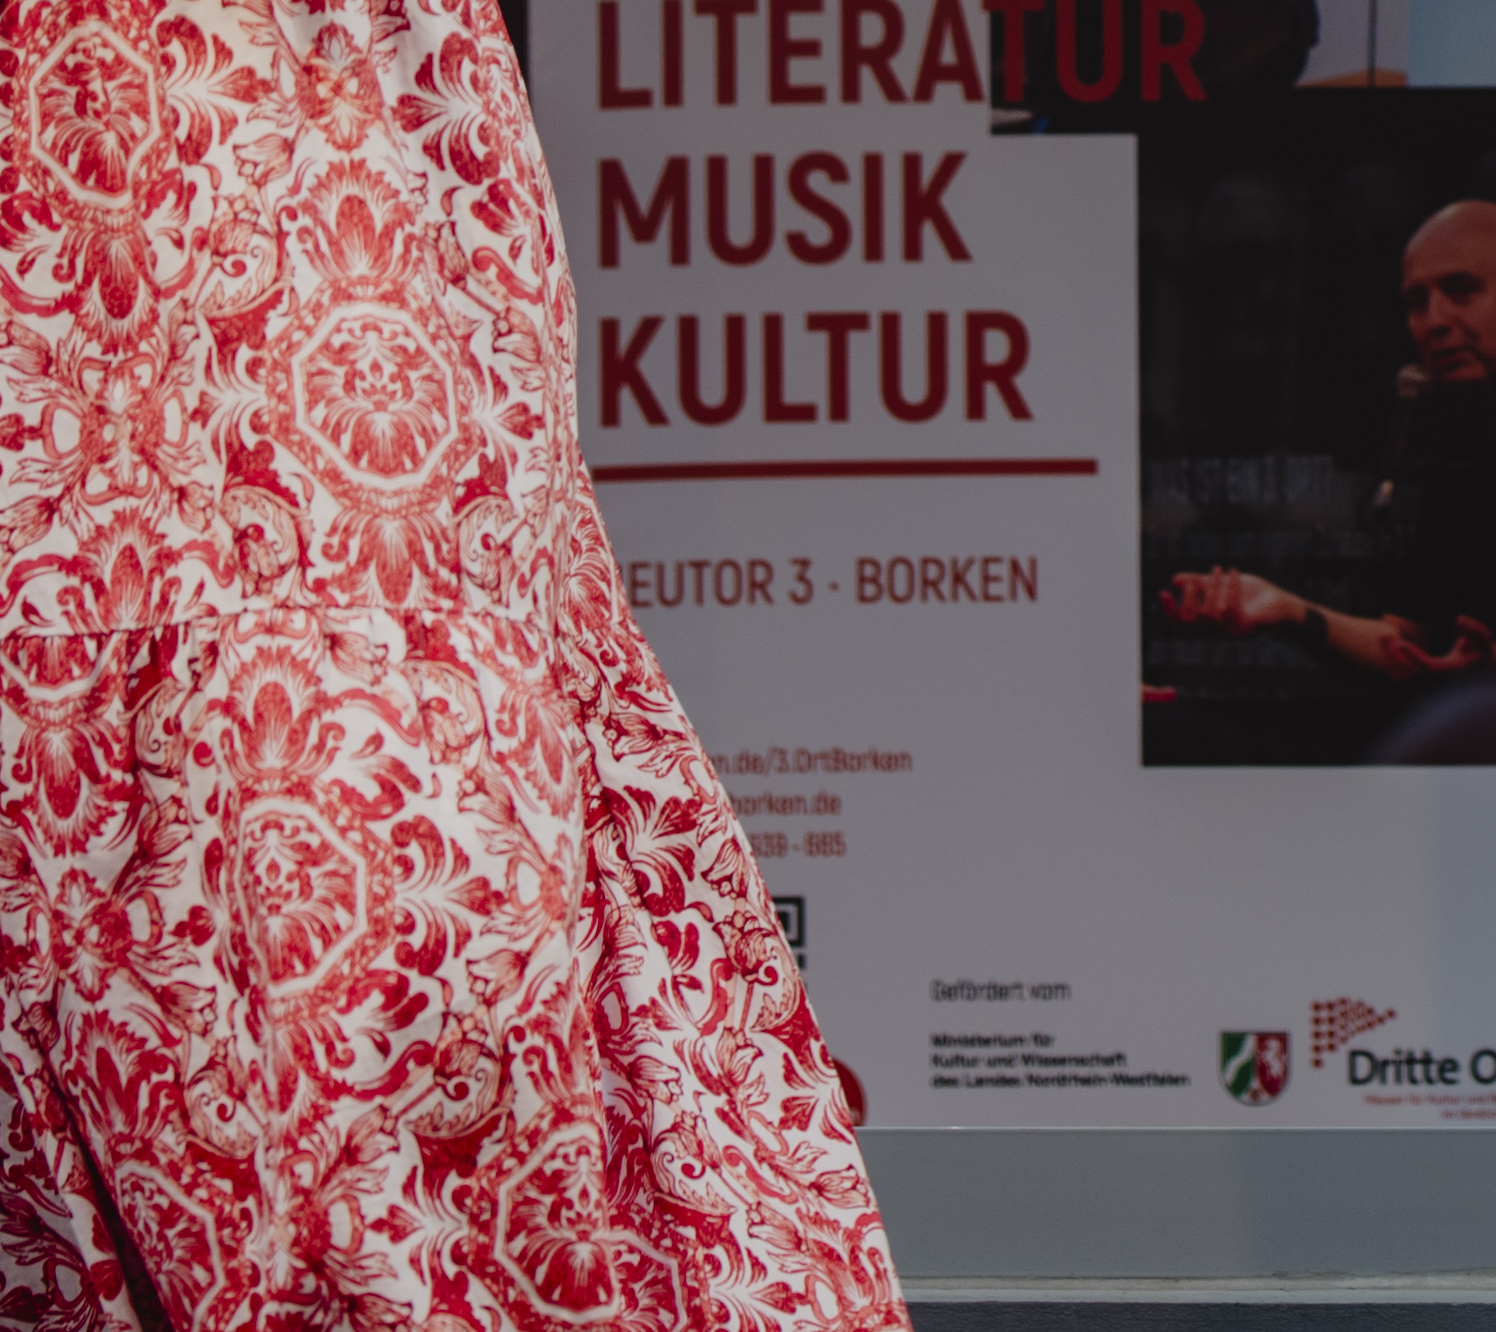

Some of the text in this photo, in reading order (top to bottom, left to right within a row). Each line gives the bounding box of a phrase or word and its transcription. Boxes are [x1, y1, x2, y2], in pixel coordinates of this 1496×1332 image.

[597, 152, 974, 269] MUSIK
[598, 309, 1033, 429] KULTUR
[622, 559, 776, 608] EUTOR
[786, 557, 815, 606] 3
[856, 555, 1039, 606] BORKEN
[930, 979, 1071, 1003] Gefördert vom
[1348, 1049, 1459, 1085] Dritte
